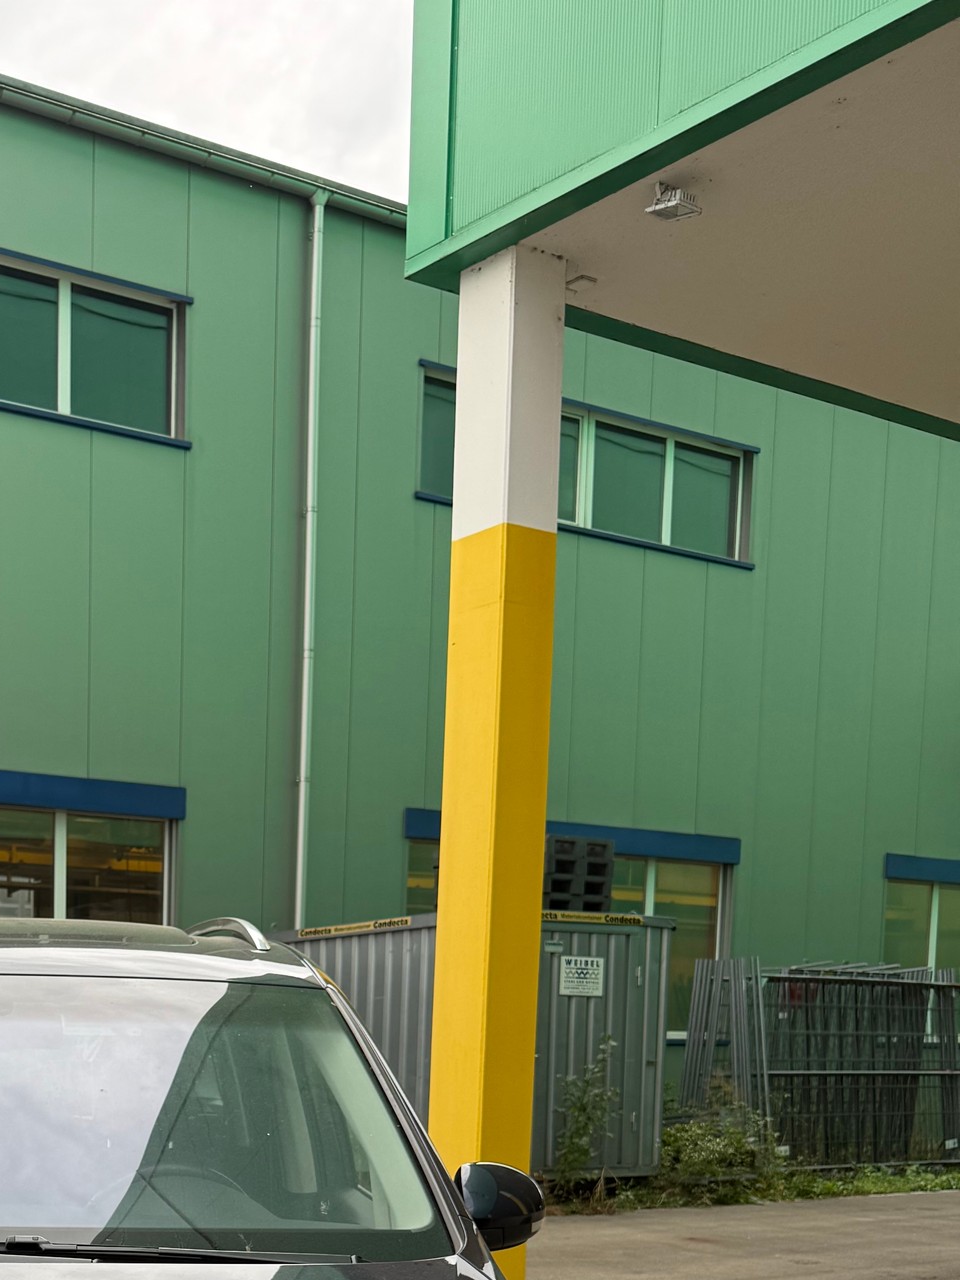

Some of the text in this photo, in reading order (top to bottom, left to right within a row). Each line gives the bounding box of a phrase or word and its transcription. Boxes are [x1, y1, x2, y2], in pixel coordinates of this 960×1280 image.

[604, 914, 641, 925] Condecta
[300, 928, 331, 937] Condecta
[373, 918, 408, 929] Condecta
[564, 958, 600, 968] WEIBEL
